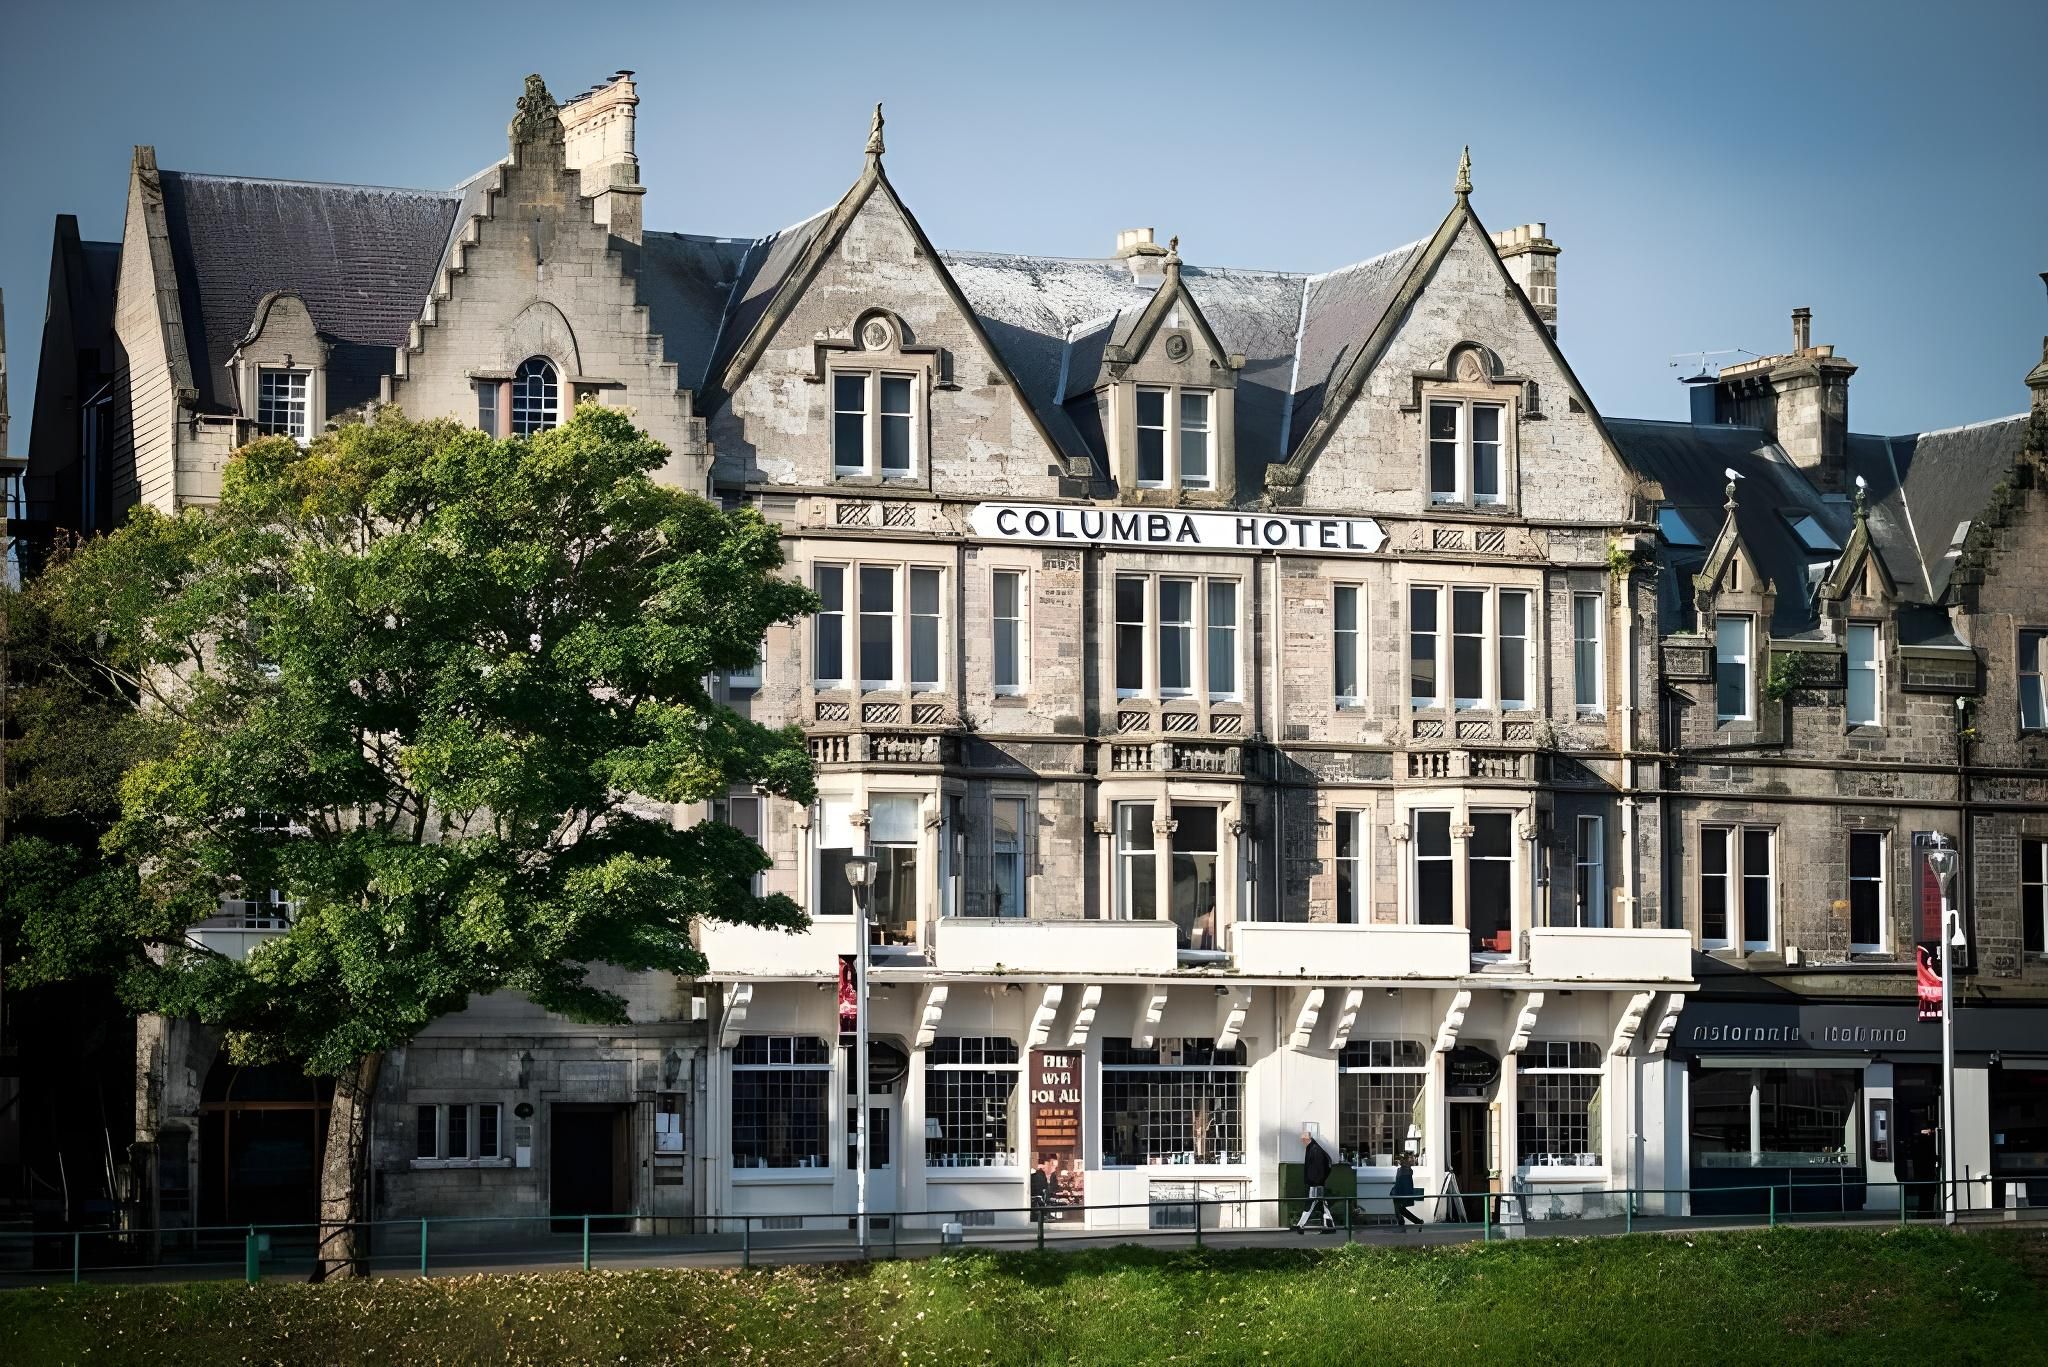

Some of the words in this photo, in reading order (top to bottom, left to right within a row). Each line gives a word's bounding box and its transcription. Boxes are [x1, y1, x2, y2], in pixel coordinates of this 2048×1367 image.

[996, 508, 1201, 544] COLUMBA
[1236, 517, 1368, 549] HOTEL
[1059, 1088, 1080, 1103] ALL
